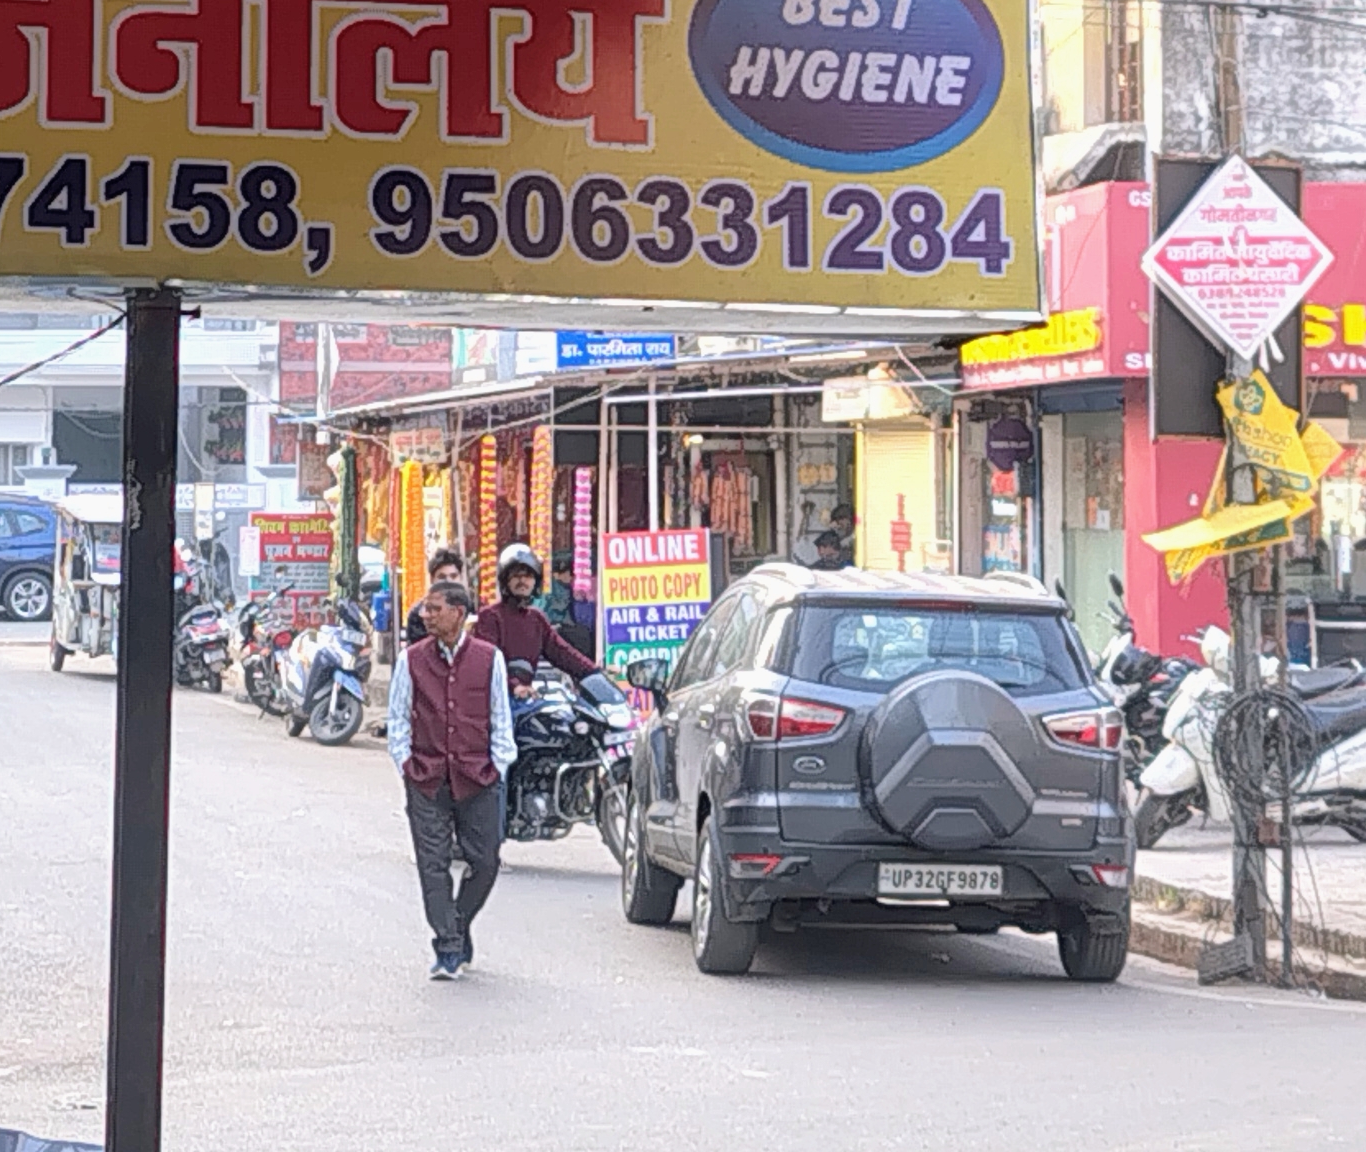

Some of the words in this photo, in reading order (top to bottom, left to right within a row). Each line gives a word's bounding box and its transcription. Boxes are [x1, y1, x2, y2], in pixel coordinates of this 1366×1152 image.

[728, 45, 972, 108] HYGIENE
[371, 166, 1012, 274] 9506331284
[608, 534, 700, 564] ONLINE
[609, 573, 659, 602] PHOTO
[663, 572, 702, 598] COPY
[610, 607, 641, 625] AIR
[646, 606, 659, 622] &
[664, 604, 706, 621] RAIL
[627, 623, 690, 643] TICKET
[891, 869, 1000, 891] UP32GF9878
